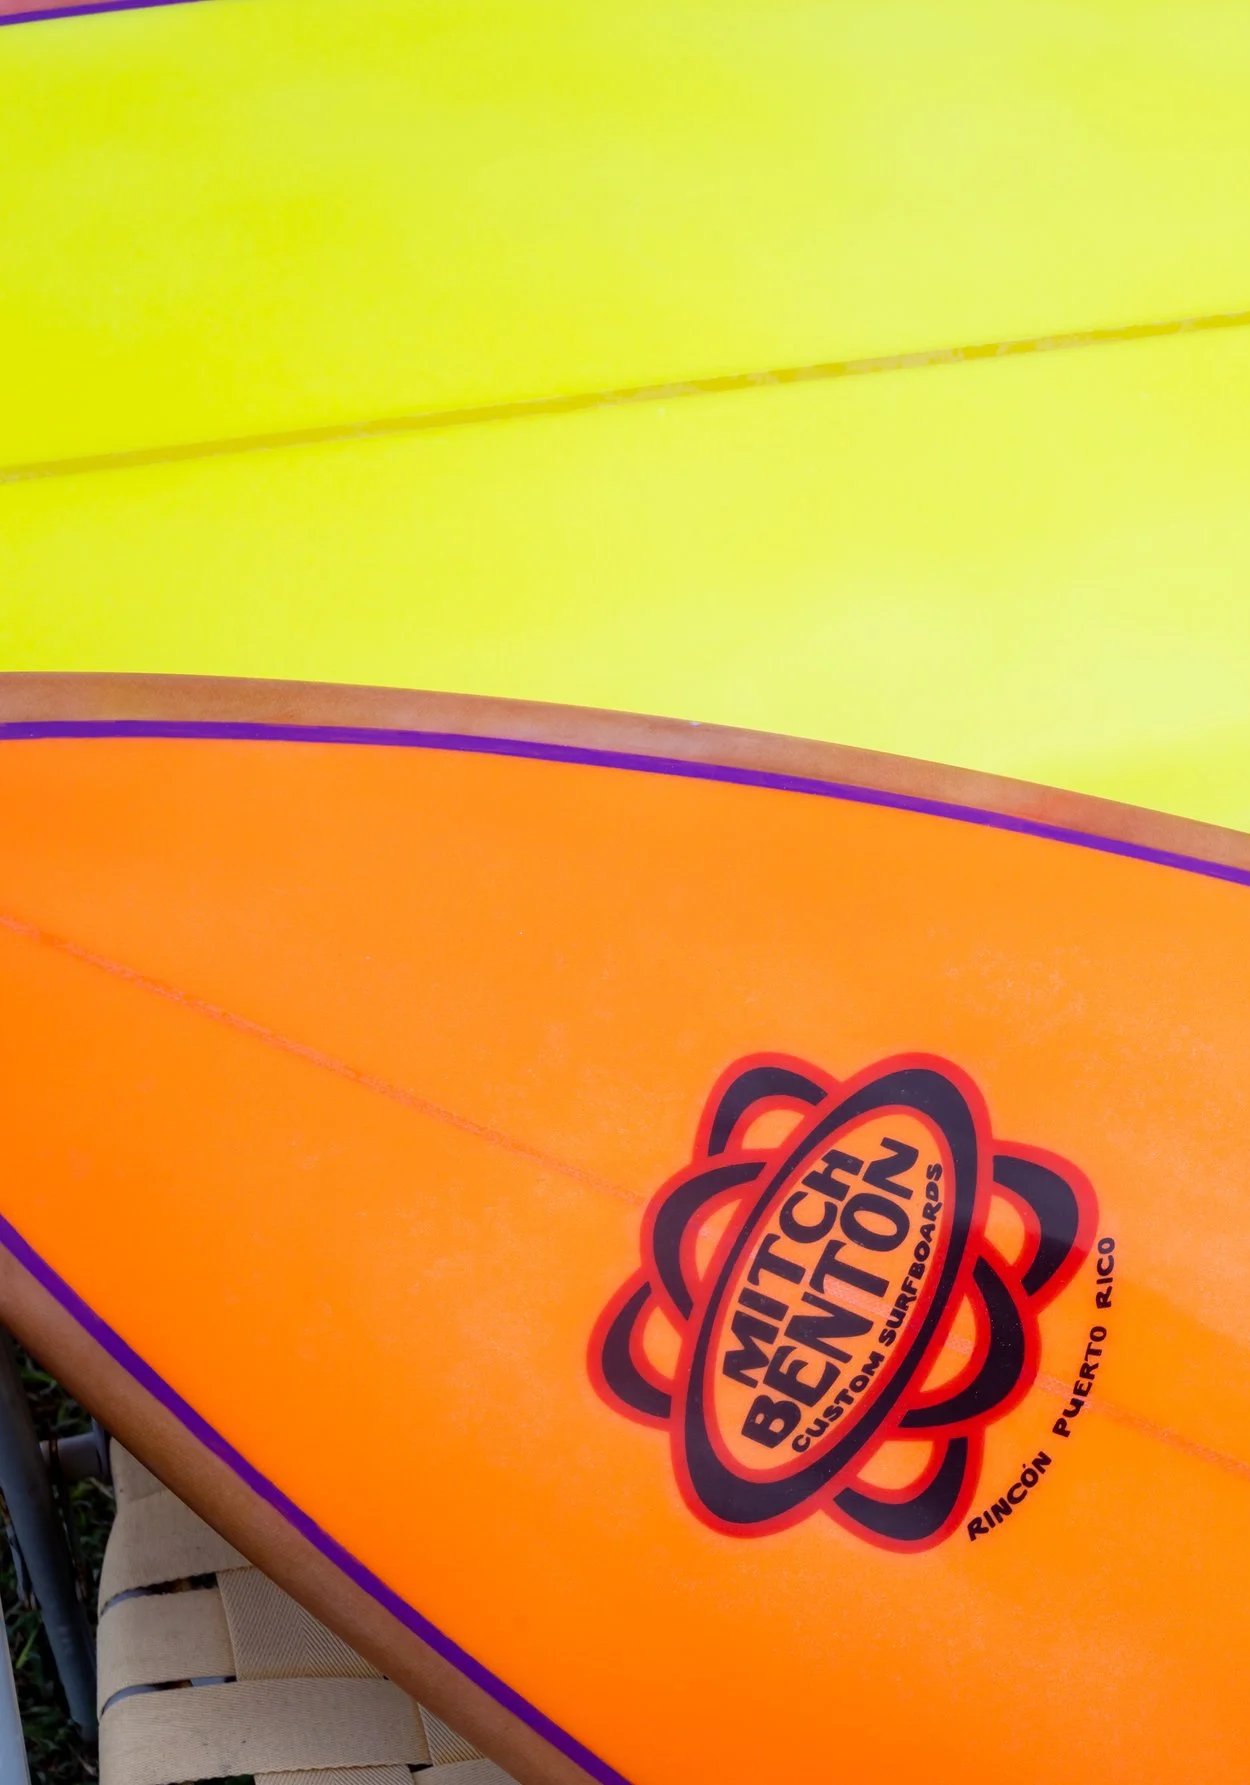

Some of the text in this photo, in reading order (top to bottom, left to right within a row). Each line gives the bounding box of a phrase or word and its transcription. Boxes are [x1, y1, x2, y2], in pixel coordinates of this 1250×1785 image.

[722, 1148, 865, 1389] MITCH
[741, 1136, 920, 1450] BENTON
[790, 1162, 943, 1454] CUSTOM SURFBOARDS
[965, 1236, 1115, 1541] RINCÓN PUERTO RICO
